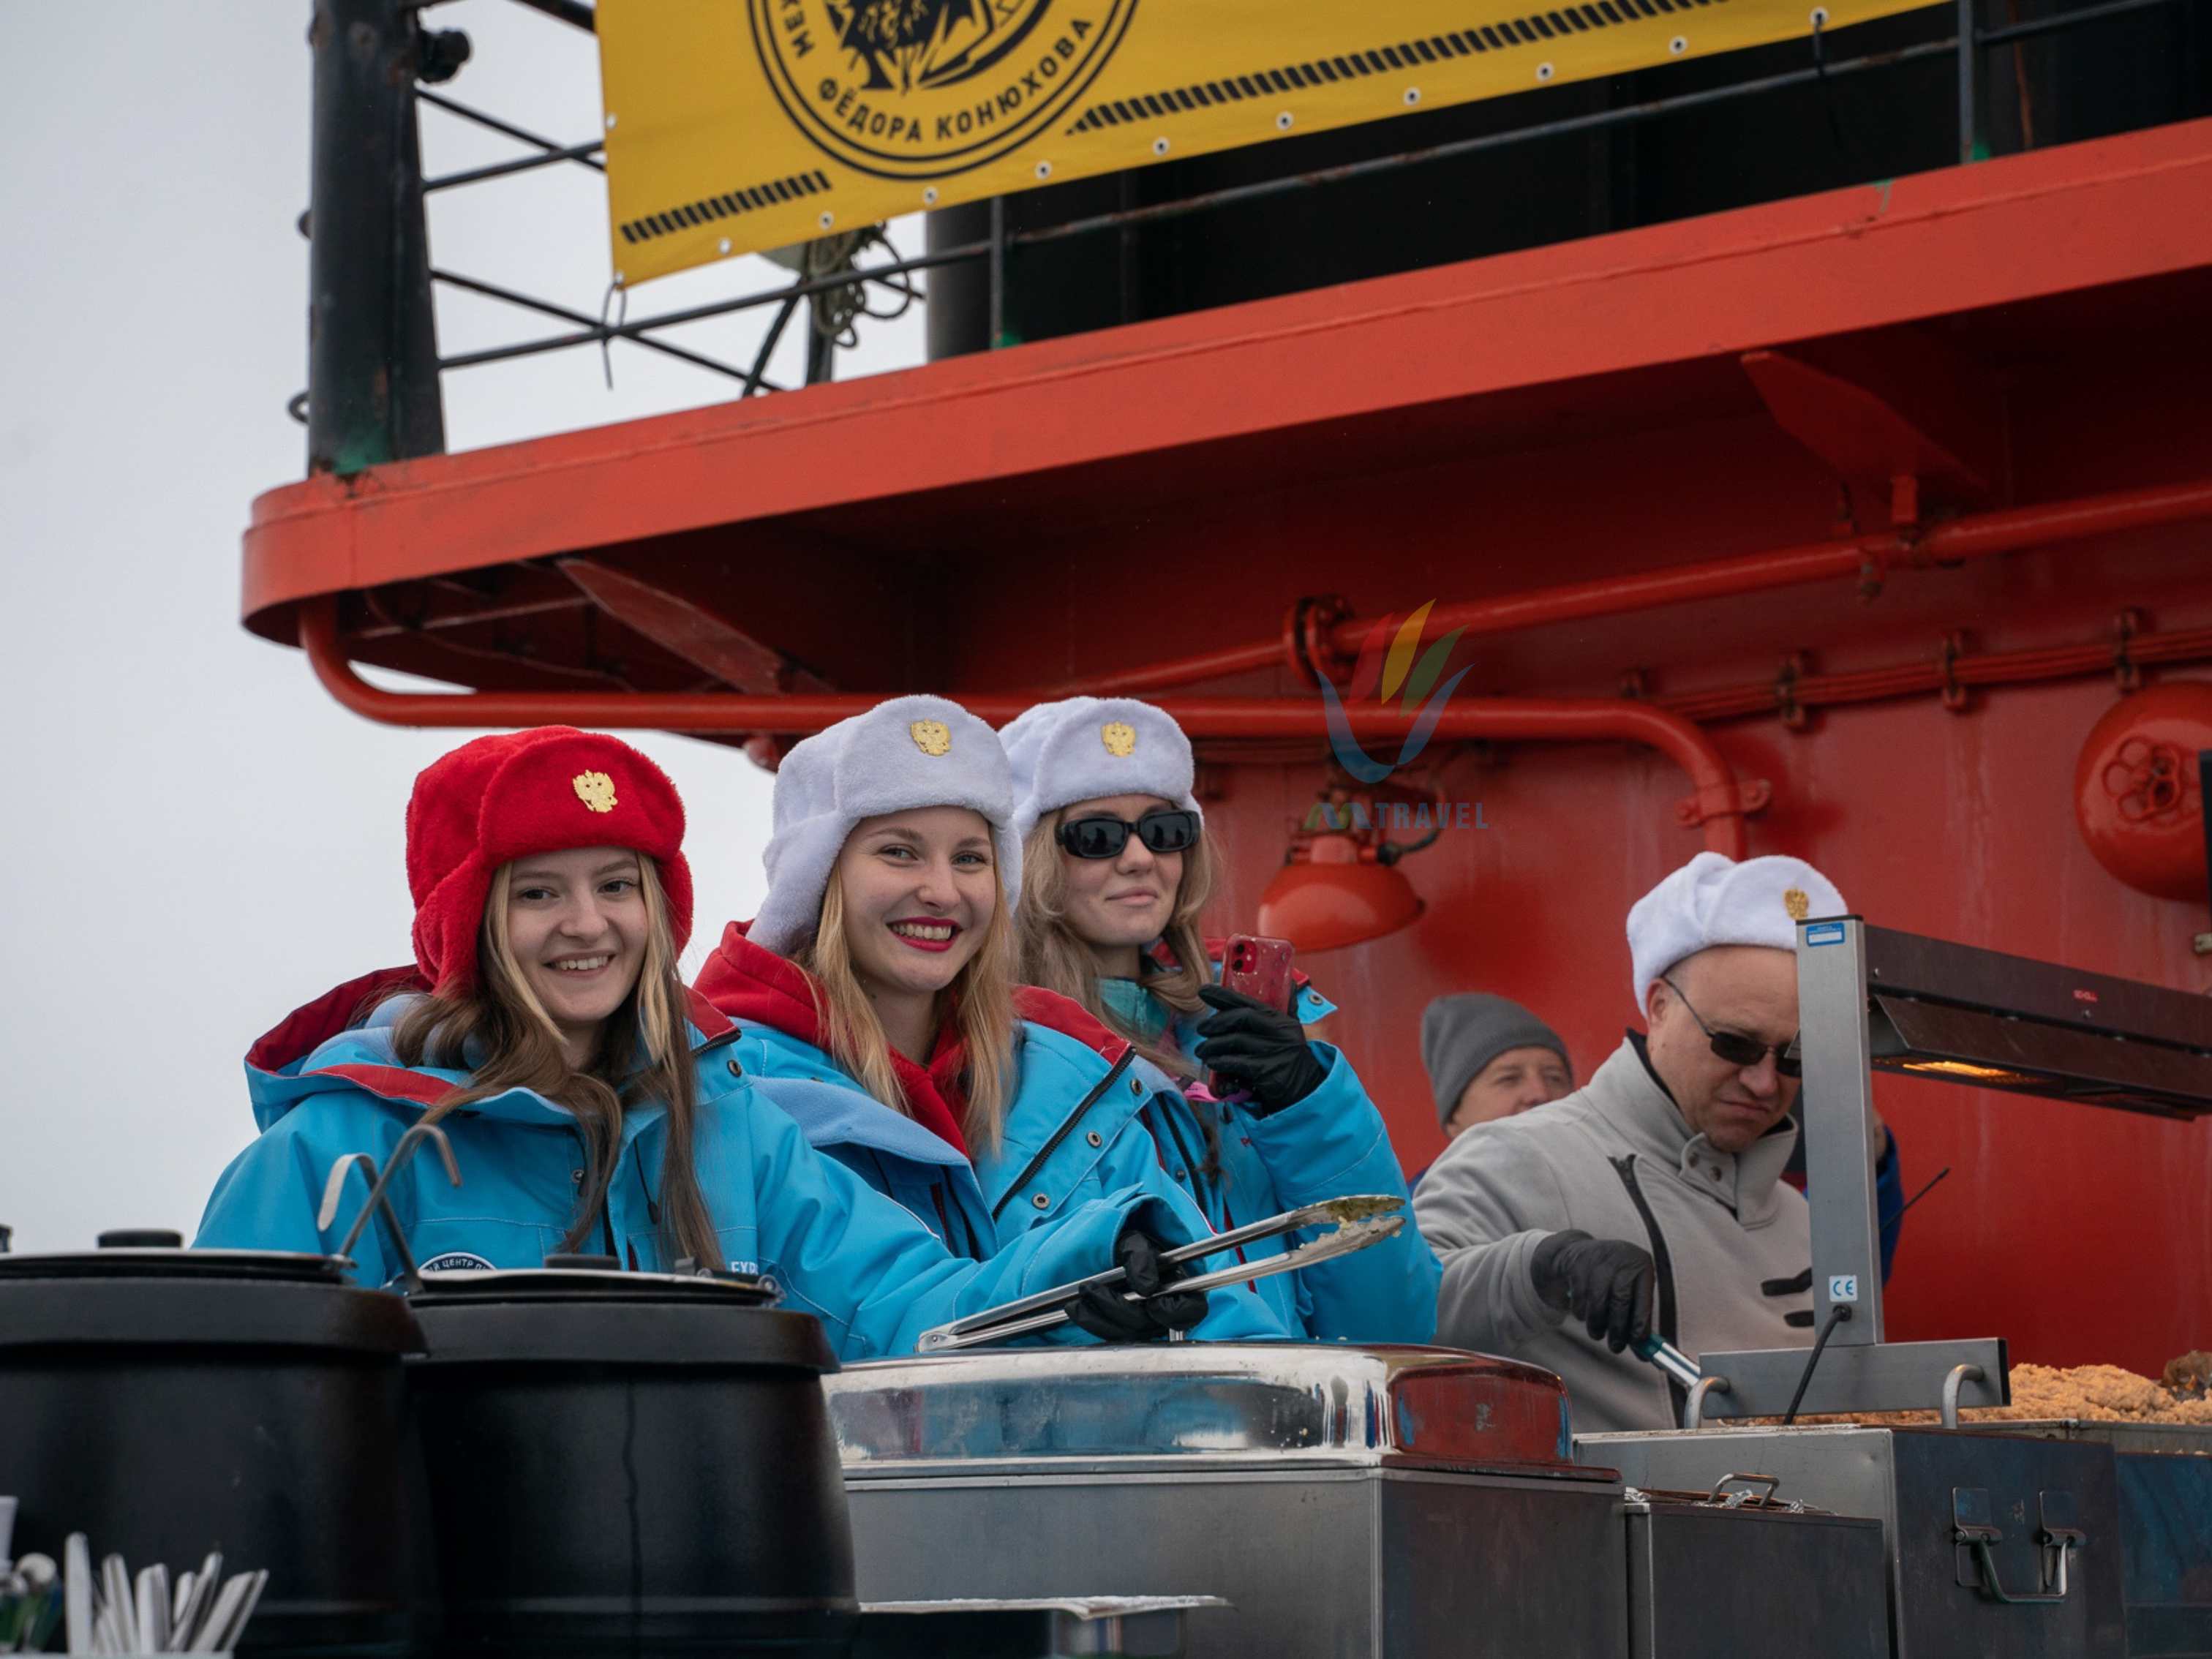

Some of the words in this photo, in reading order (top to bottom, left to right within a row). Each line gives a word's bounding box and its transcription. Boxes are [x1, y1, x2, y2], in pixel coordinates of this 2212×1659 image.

[819, 78, 922, 141] ФЁДОРА
[936, 18, 1093, 140] КОНЮХОВА
[442, 1258, 475, 1268] ЦЕНТР
[1833, 1280, 1854, 1296] CE
